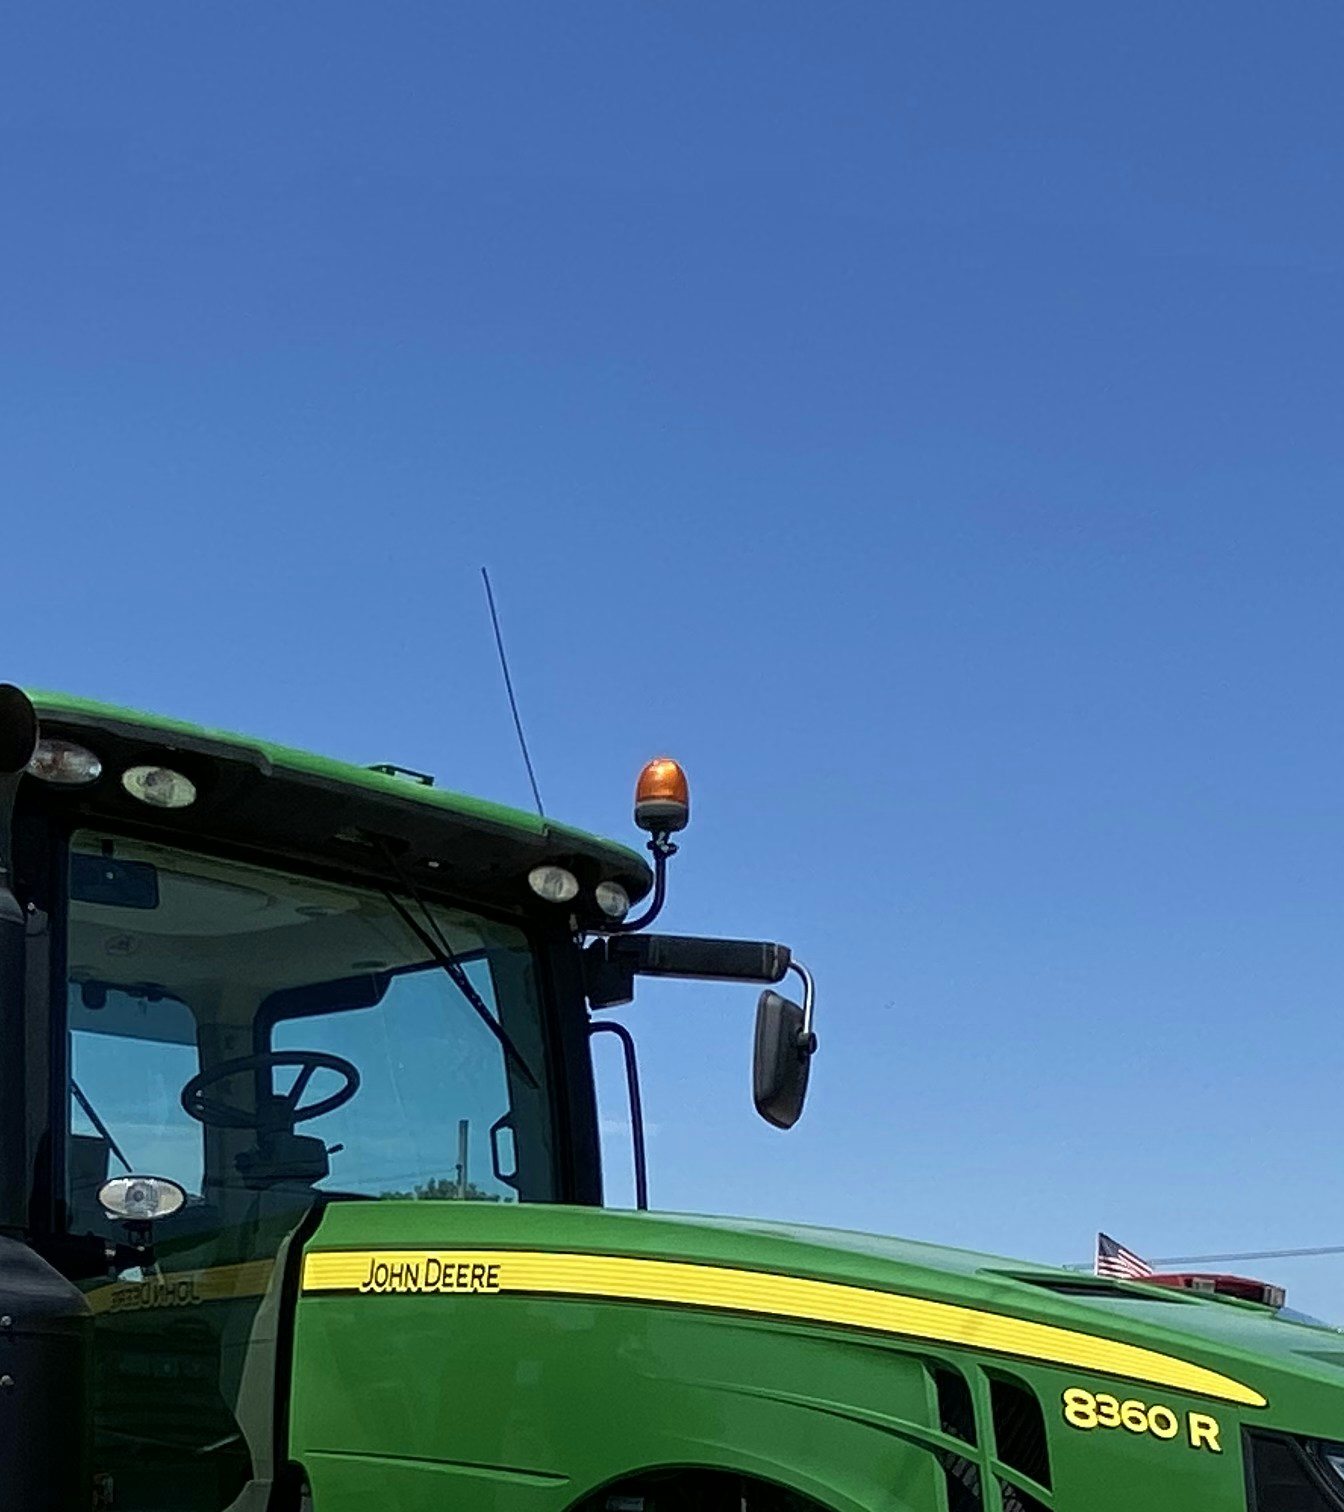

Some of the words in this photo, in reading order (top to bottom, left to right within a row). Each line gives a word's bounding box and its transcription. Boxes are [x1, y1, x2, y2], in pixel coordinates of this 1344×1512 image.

[362, 1257, 420, 1288] JOHN
[424, 1257, 501, 1288] DEERE
[1062, 1387, 1179, 1439] 8360
[1187, 1411, 1223, 1453] R
